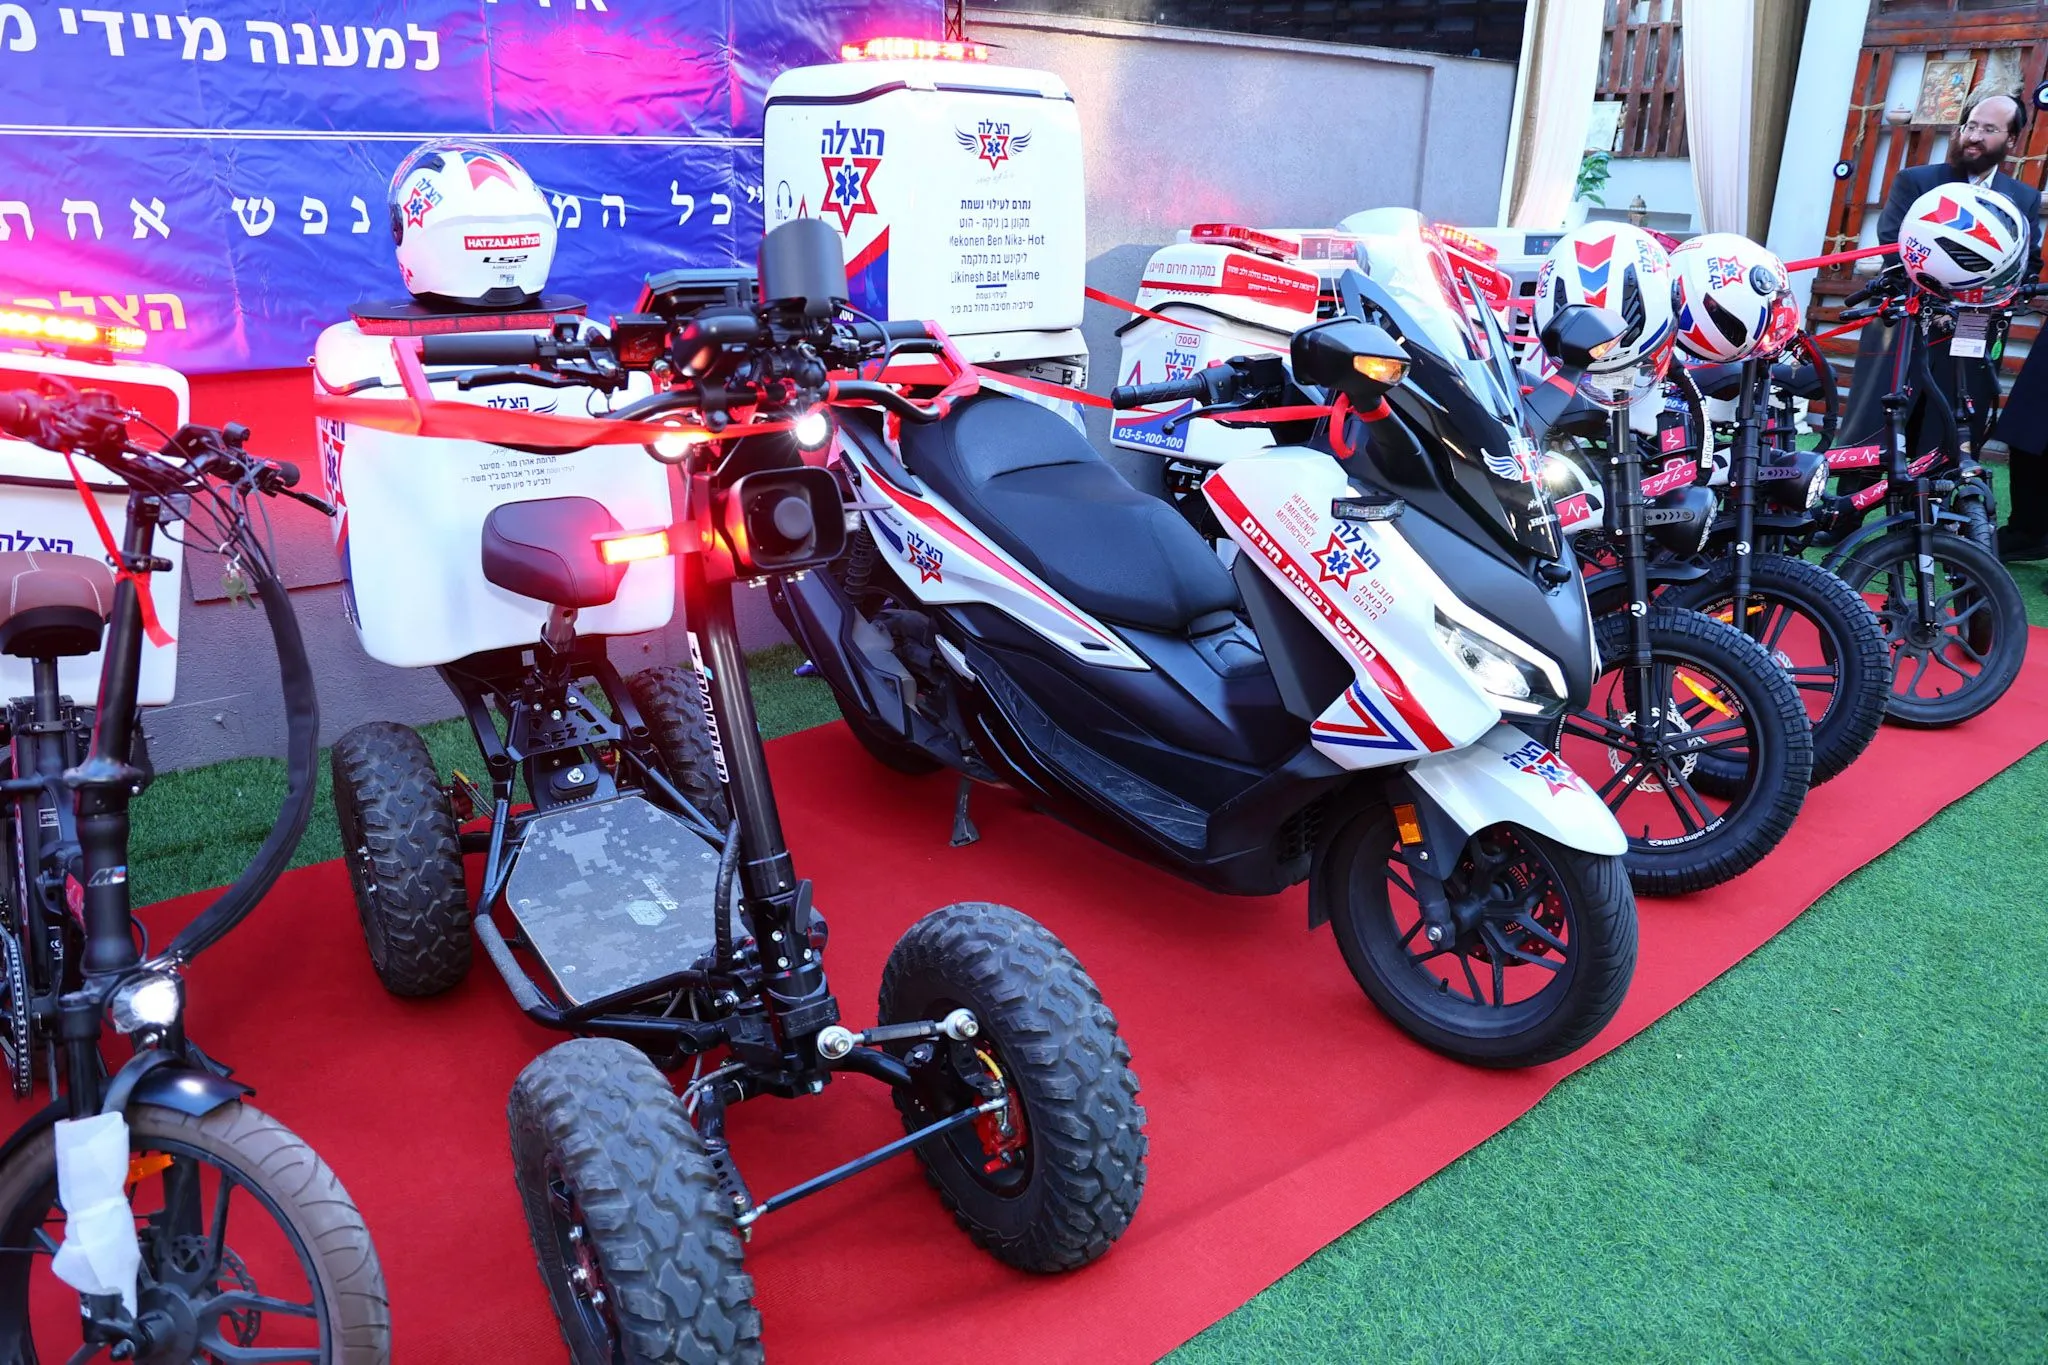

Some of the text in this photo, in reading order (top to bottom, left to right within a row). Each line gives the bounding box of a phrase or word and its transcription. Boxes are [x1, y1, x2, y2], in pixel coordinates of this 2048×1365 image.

[60, 8, 227, 62] מיידי
[247, 19, 440, 71] למענה
[821, 120, 885, 156] הצלה
[978, 118, 1010, 135] הצלה
[415, 178, 443, 206] הצלה
[960, 198, 1031, 210] נתרם לעילוי נשמת
[230, 195, 371, 237] נפש
[467, 238, 519, 248] HATZALAH
[987, 234, 1003, 246] Ben
[1027, 234, 1045, 245] Hot
[1906, 236, 1932, 257] הצלה
[990, 254, 1001, 264] בת
[1166, 263, 1188, 275] חירום
[1190, 263, 1216, 279] במקרה
[951, 269, 1040, 283] Likinesh Bat Melkame
[1177, 335, 1198, 346] 7004
[1165, 349, 1196, 367] הצלה
[487, 396, 529, 408] הצלה
[1119, 427, 1184, 449] 03-5-100-100
[1283, 501, 1318, 538] EMERGENCY
[1291, 492, 1320, 523] HATZALAH
[1274, 509, 1312, 550] MOTORCYCLE
[906, 530, 943, 564] הצלה
[1334, 520, 1381, 571] הצלה
[1240, 515, 1378, 663] חובש רפואת חירום
[1359, 584, 1389, 615] רפואת
[1370, 578, 1396, 605] חובש
[1353, 594, 1379, 621] חירום
[1502, 741, 1546, 769] הצלה
[1662, 817, 1725, 847] RIDER Super Sport
